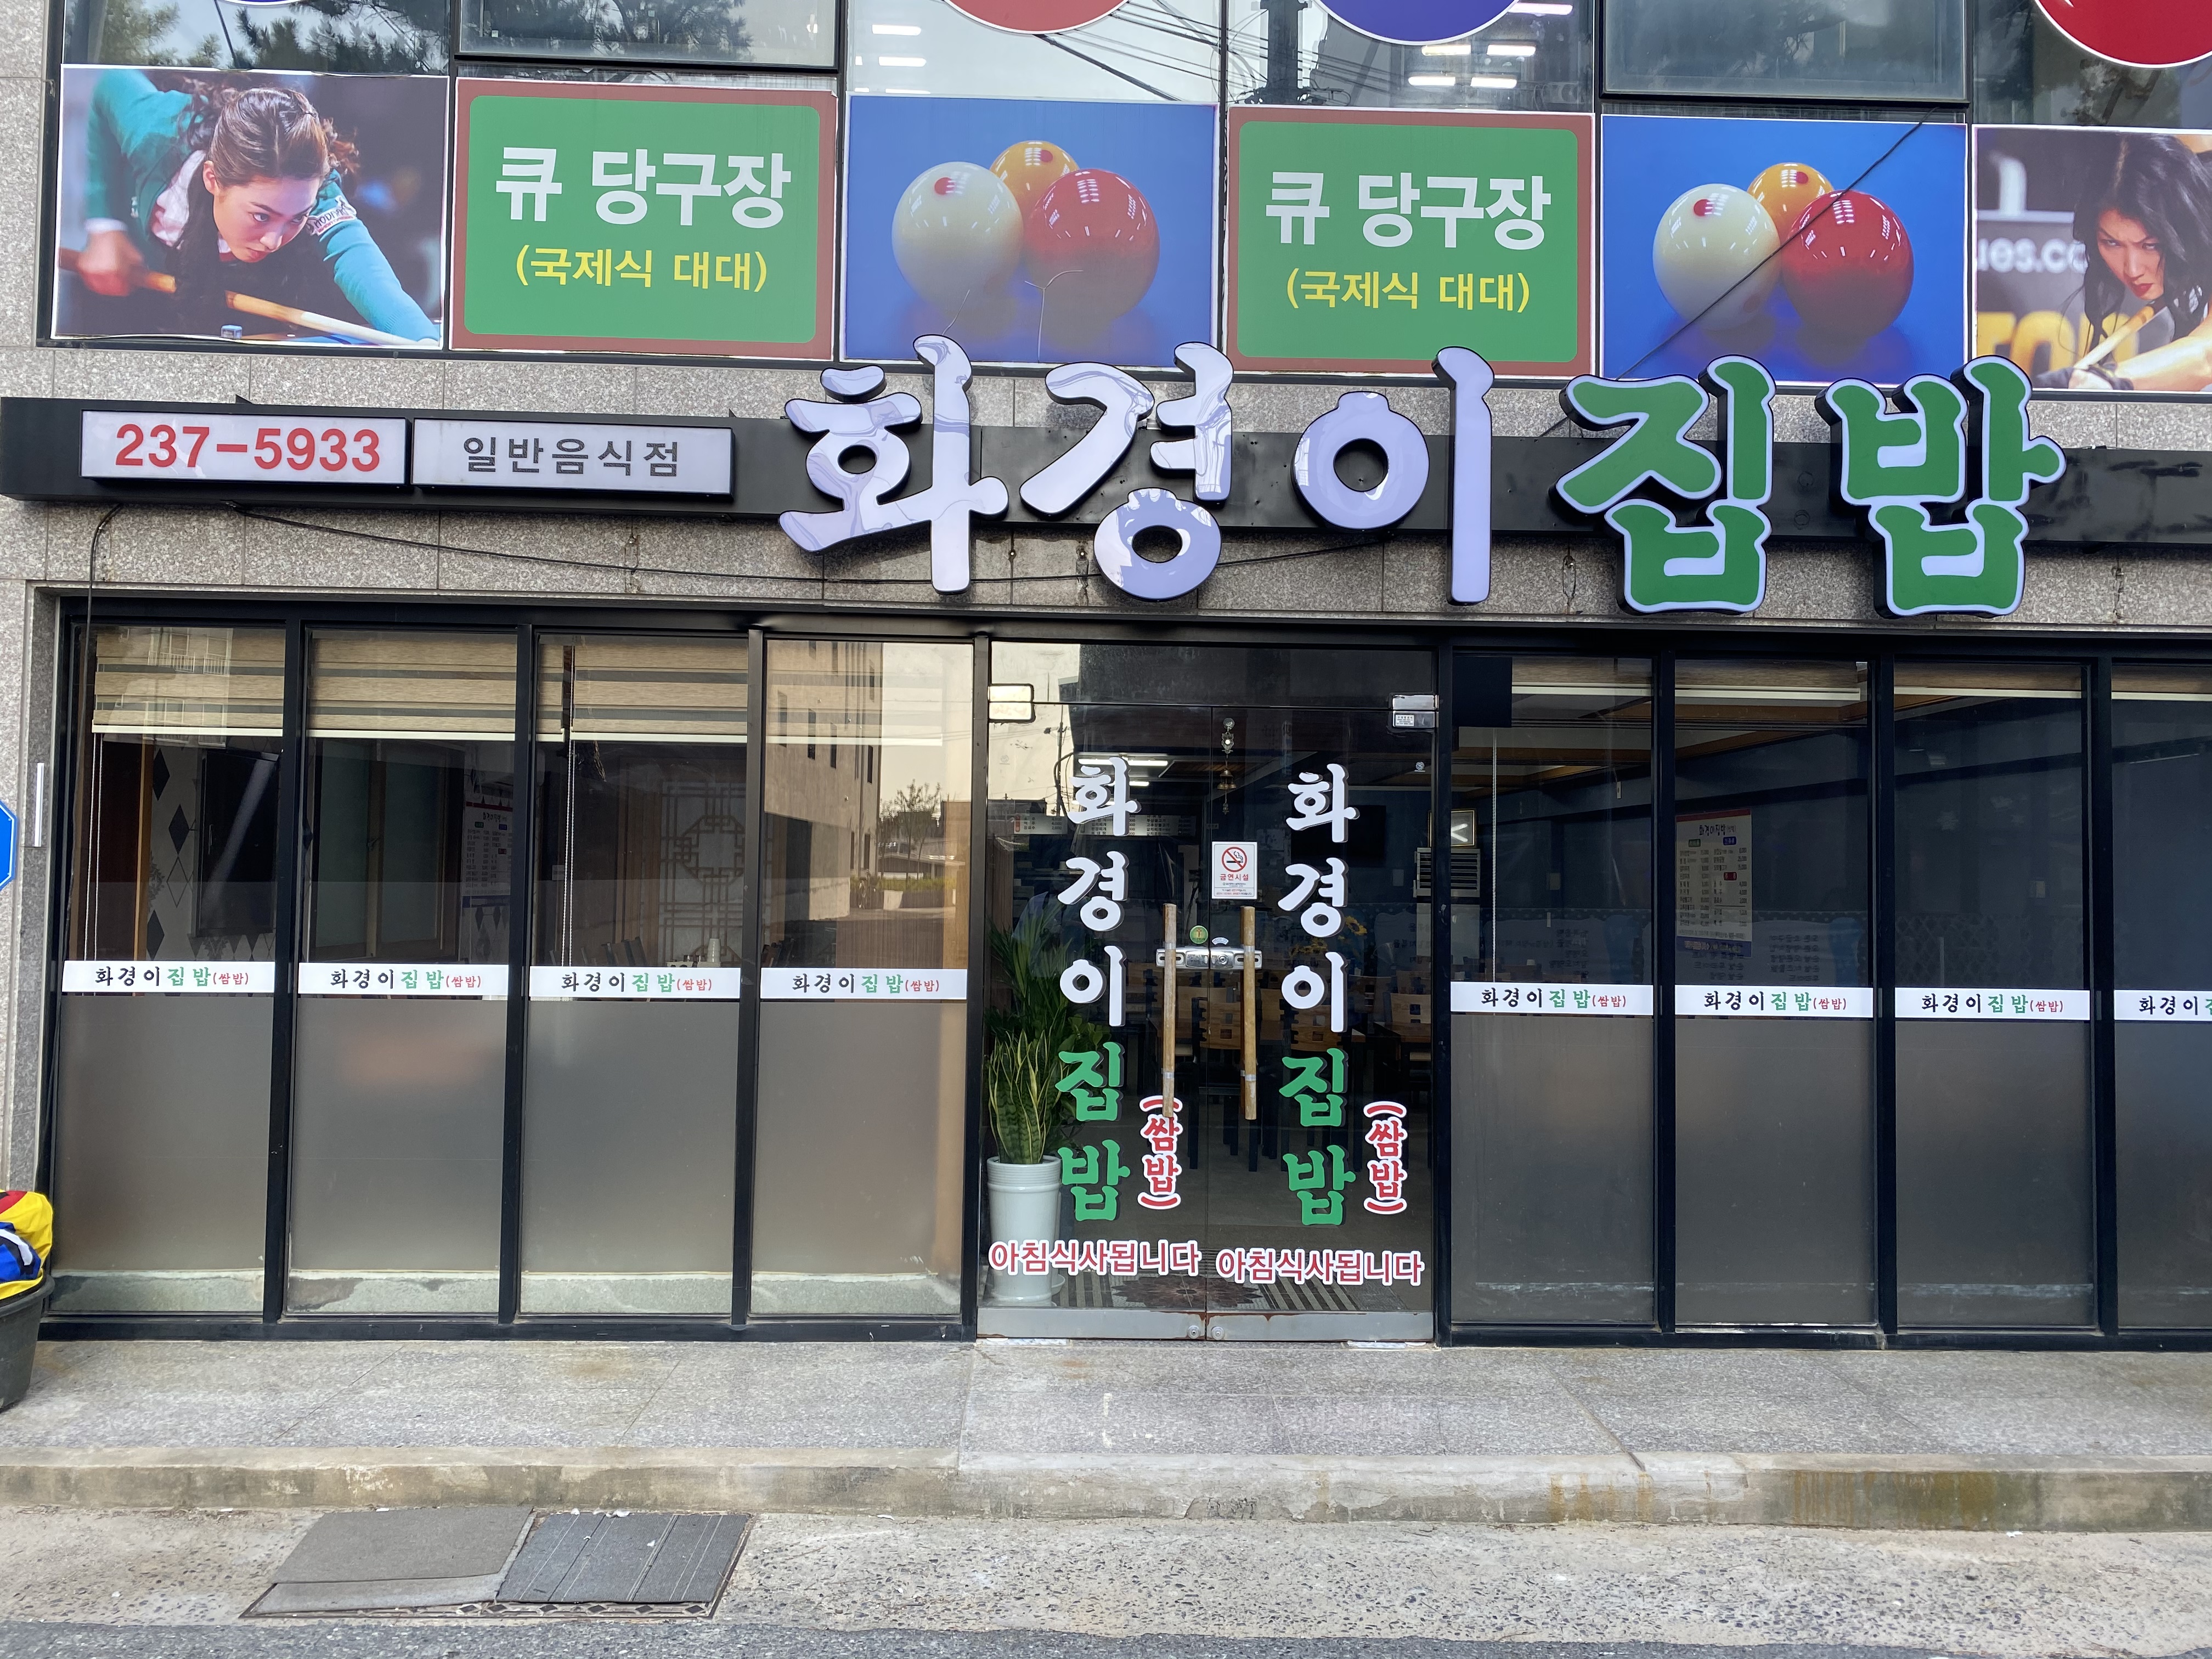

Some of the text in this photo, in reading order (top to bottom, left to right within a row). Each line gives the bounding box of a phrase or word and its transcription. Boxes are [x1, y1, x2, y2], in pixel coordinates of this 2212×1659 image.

[495, 146, 792, 229] 큐 당구장
[1266, 172, 1551, 250] 큐 당구장
[516, 245, 767, 292] (국제식 대대)
[1286, 268, 1530, 313] (국제식 대대)
[115, 424, 380, 472] 237-5933
[462, 436, 679, 477] 일반음식점
[778, 334, 2066, 617] 화경이 집밥
[96, 966, 249, 987] 화경이 집밥 (쌈밥)
[331, 969, 482, 990] 화경이 집밥 (쌈밥)
[561, 972, 712, 993] 화경이 집밥 (쌈밥)
[793, 973, 940, 994] 화경이 집밥 (쌈밥)
[1055, 757, 1140, 1221] 화경이 집밥
[1278, 763, 1359, 1225] 화경이 집밥
[1481, 988, 1627, 1009] 화경이 집밥 (쌈밥)
[1704, 990, 1847, 1012] 화경이 집밥 (쌈밥)
[1921, 993, 2064, 1014] 화경이 집밥 (쌈밥)
[1365, 1103, 1406, 1214] (쌈밥)
[990, 1240, 1201, 1275] 아침식사됩니다
[1217, 1249, 1423, 1285] 아침식사됩니다
